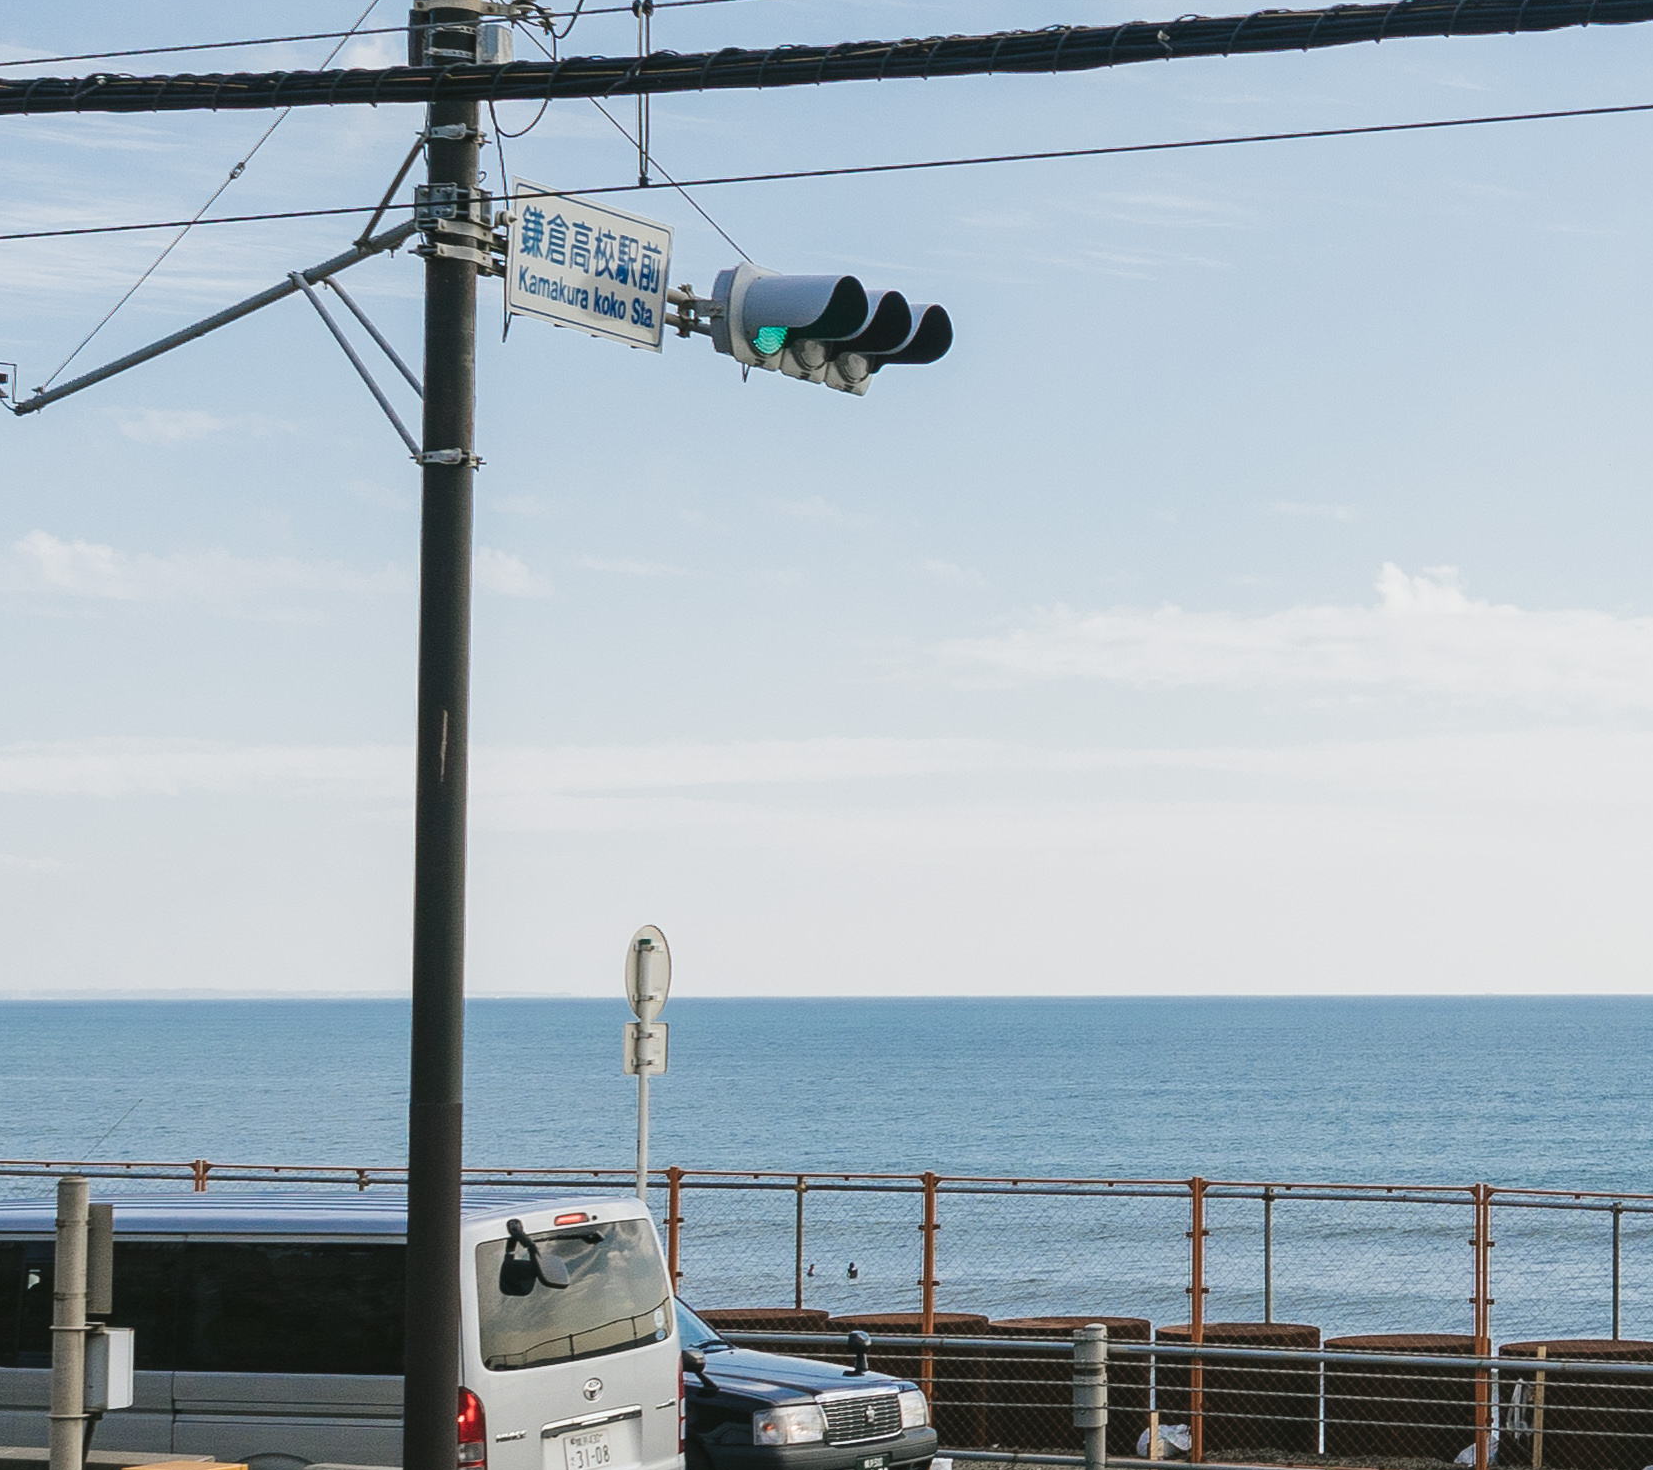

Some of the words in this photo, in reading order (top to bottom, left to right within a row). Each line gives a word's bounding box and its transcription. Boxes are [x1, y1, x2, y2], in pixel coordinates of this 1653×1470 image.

[520, 204, 663, 294] 鎌倉高校駅前
[518, 265, 589, 310] Kamakura
[593, 284, 627, 320] koko
[631, 298, 655, 328] Sta.
[576, 1445, 610, 1468] 31-08
